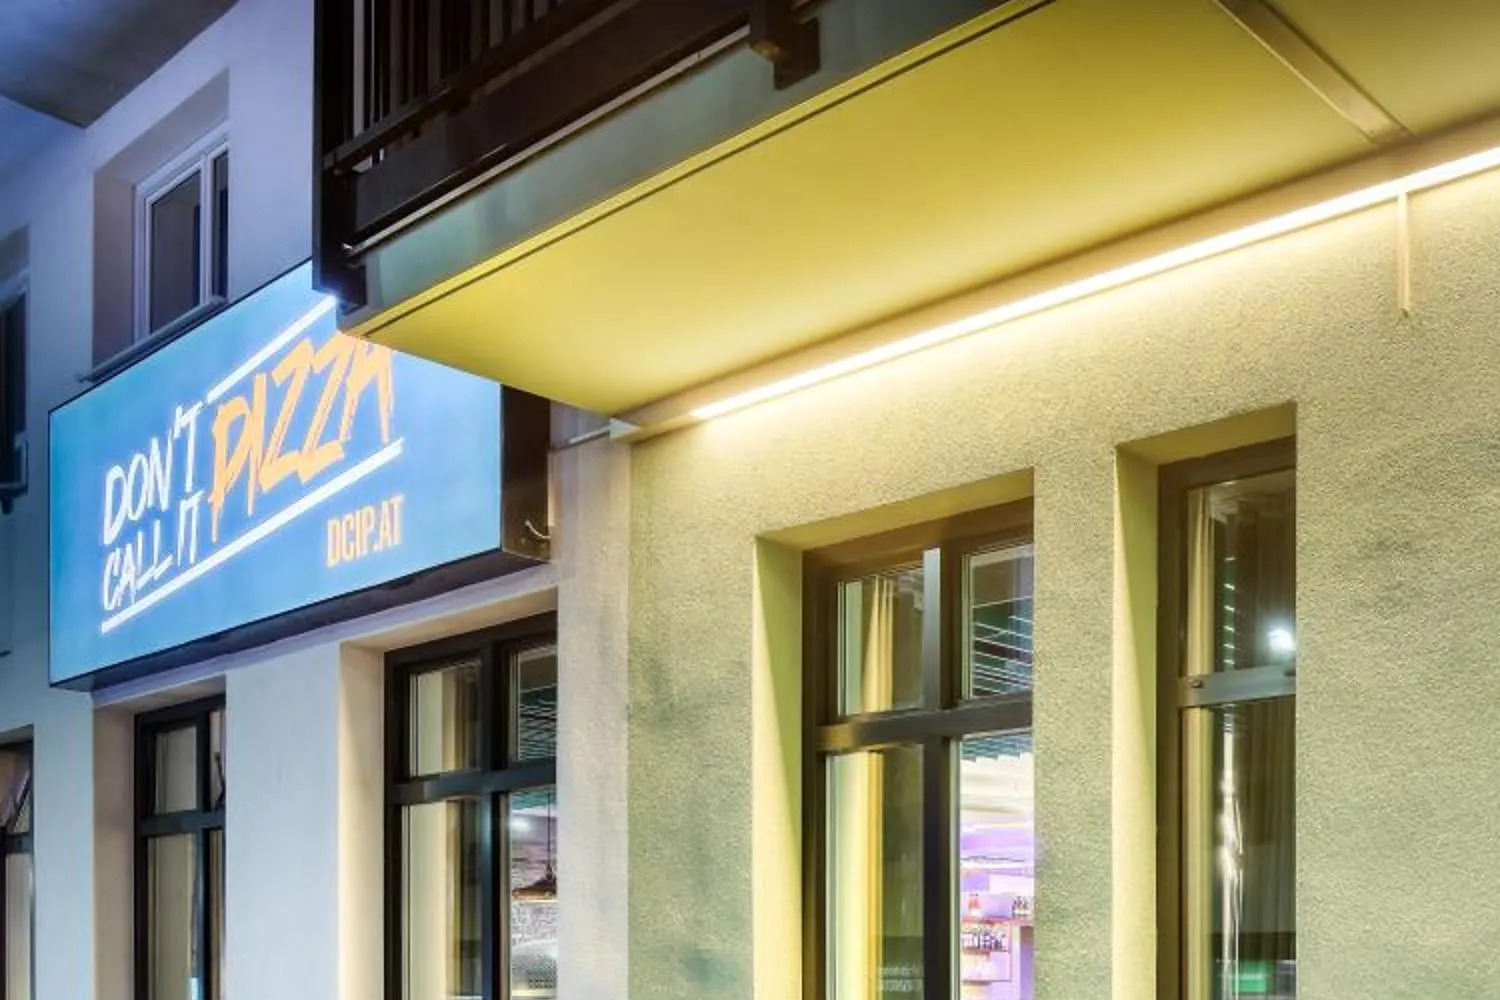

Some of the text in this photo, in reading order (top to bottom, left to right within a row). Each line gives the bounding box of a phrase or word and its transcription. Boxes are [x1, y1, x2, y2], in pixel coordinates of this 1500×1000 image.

[103, 402, 203, 545] DON'T
[207, 330, 397, 544] PIZZA
[103, 490, 205, 611] CALL IT
[326, 496, 404, 569] DCIP.AT
